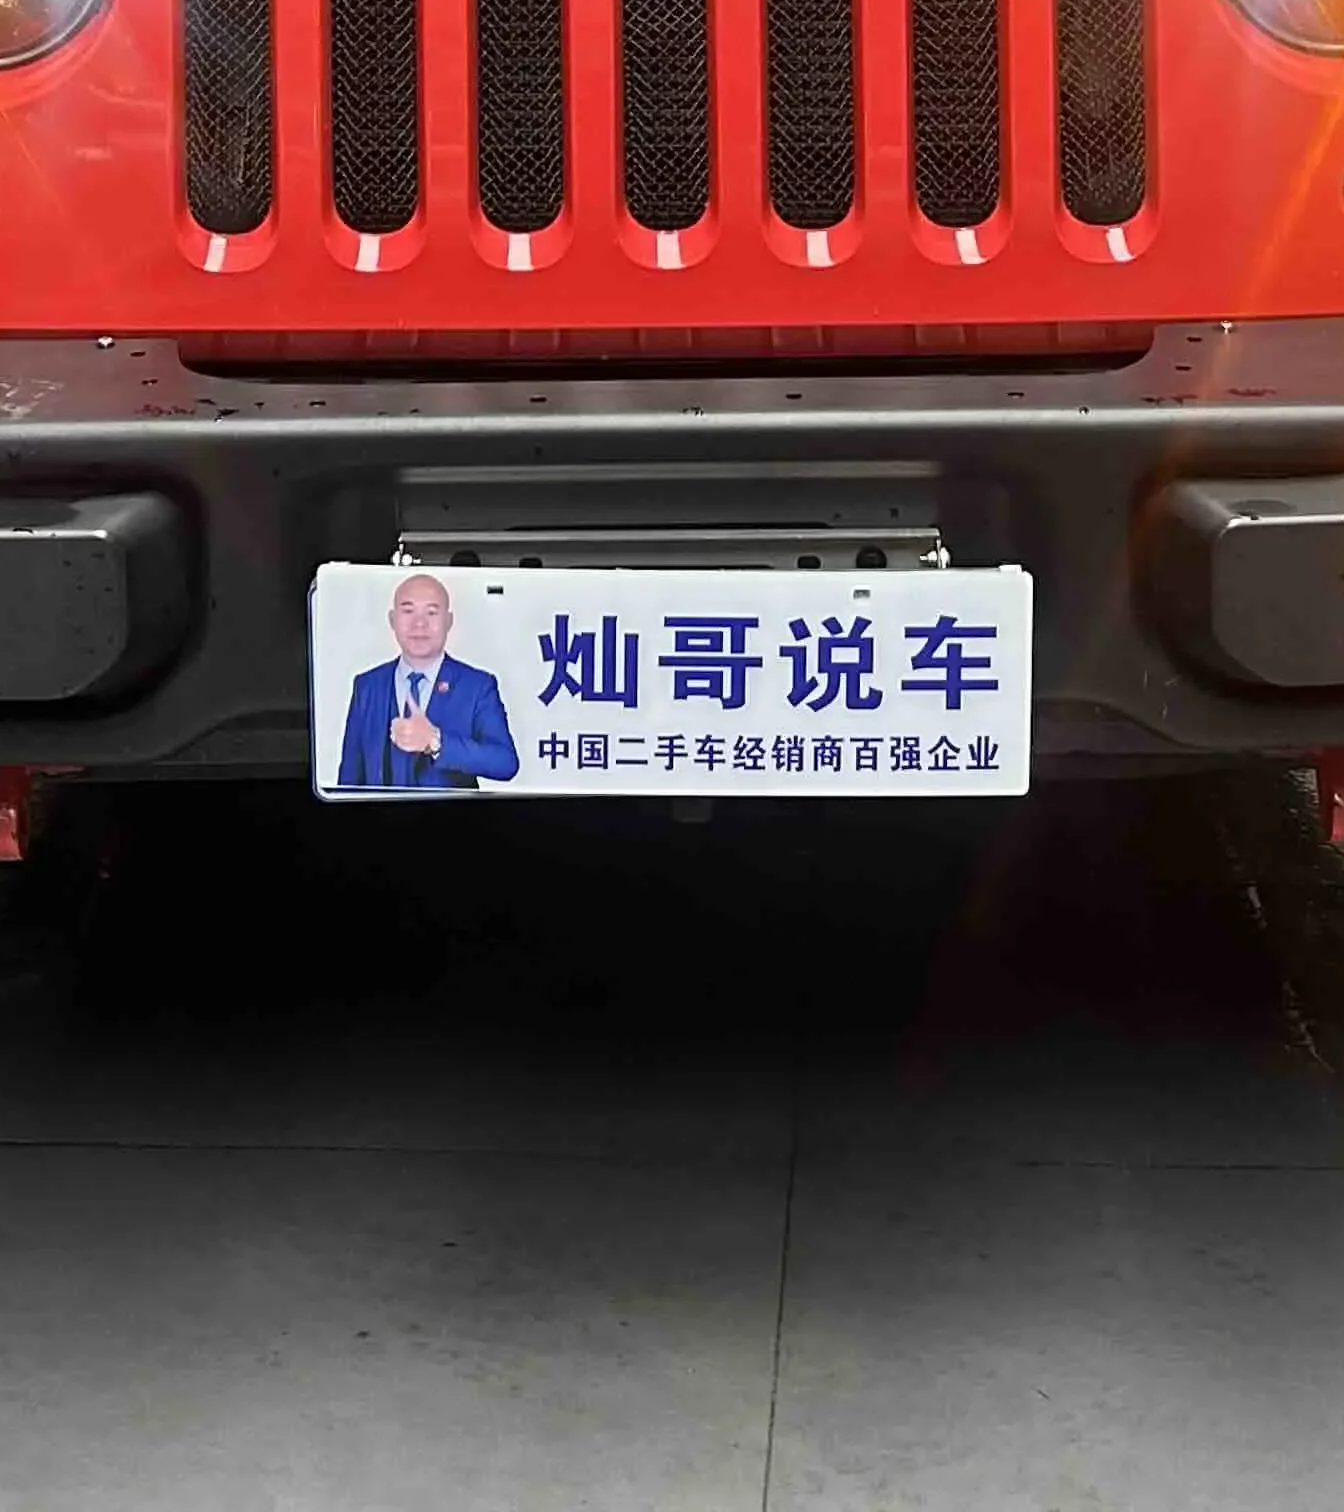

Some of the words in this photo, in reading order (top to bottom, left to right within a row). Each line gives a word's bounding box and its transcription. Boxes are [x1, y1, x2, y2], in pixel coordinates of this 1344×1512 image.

[538, 614, 1000, 712] 灿哥说车
[538, 733, 1001, 772] 中国二手车经销商百强企业
